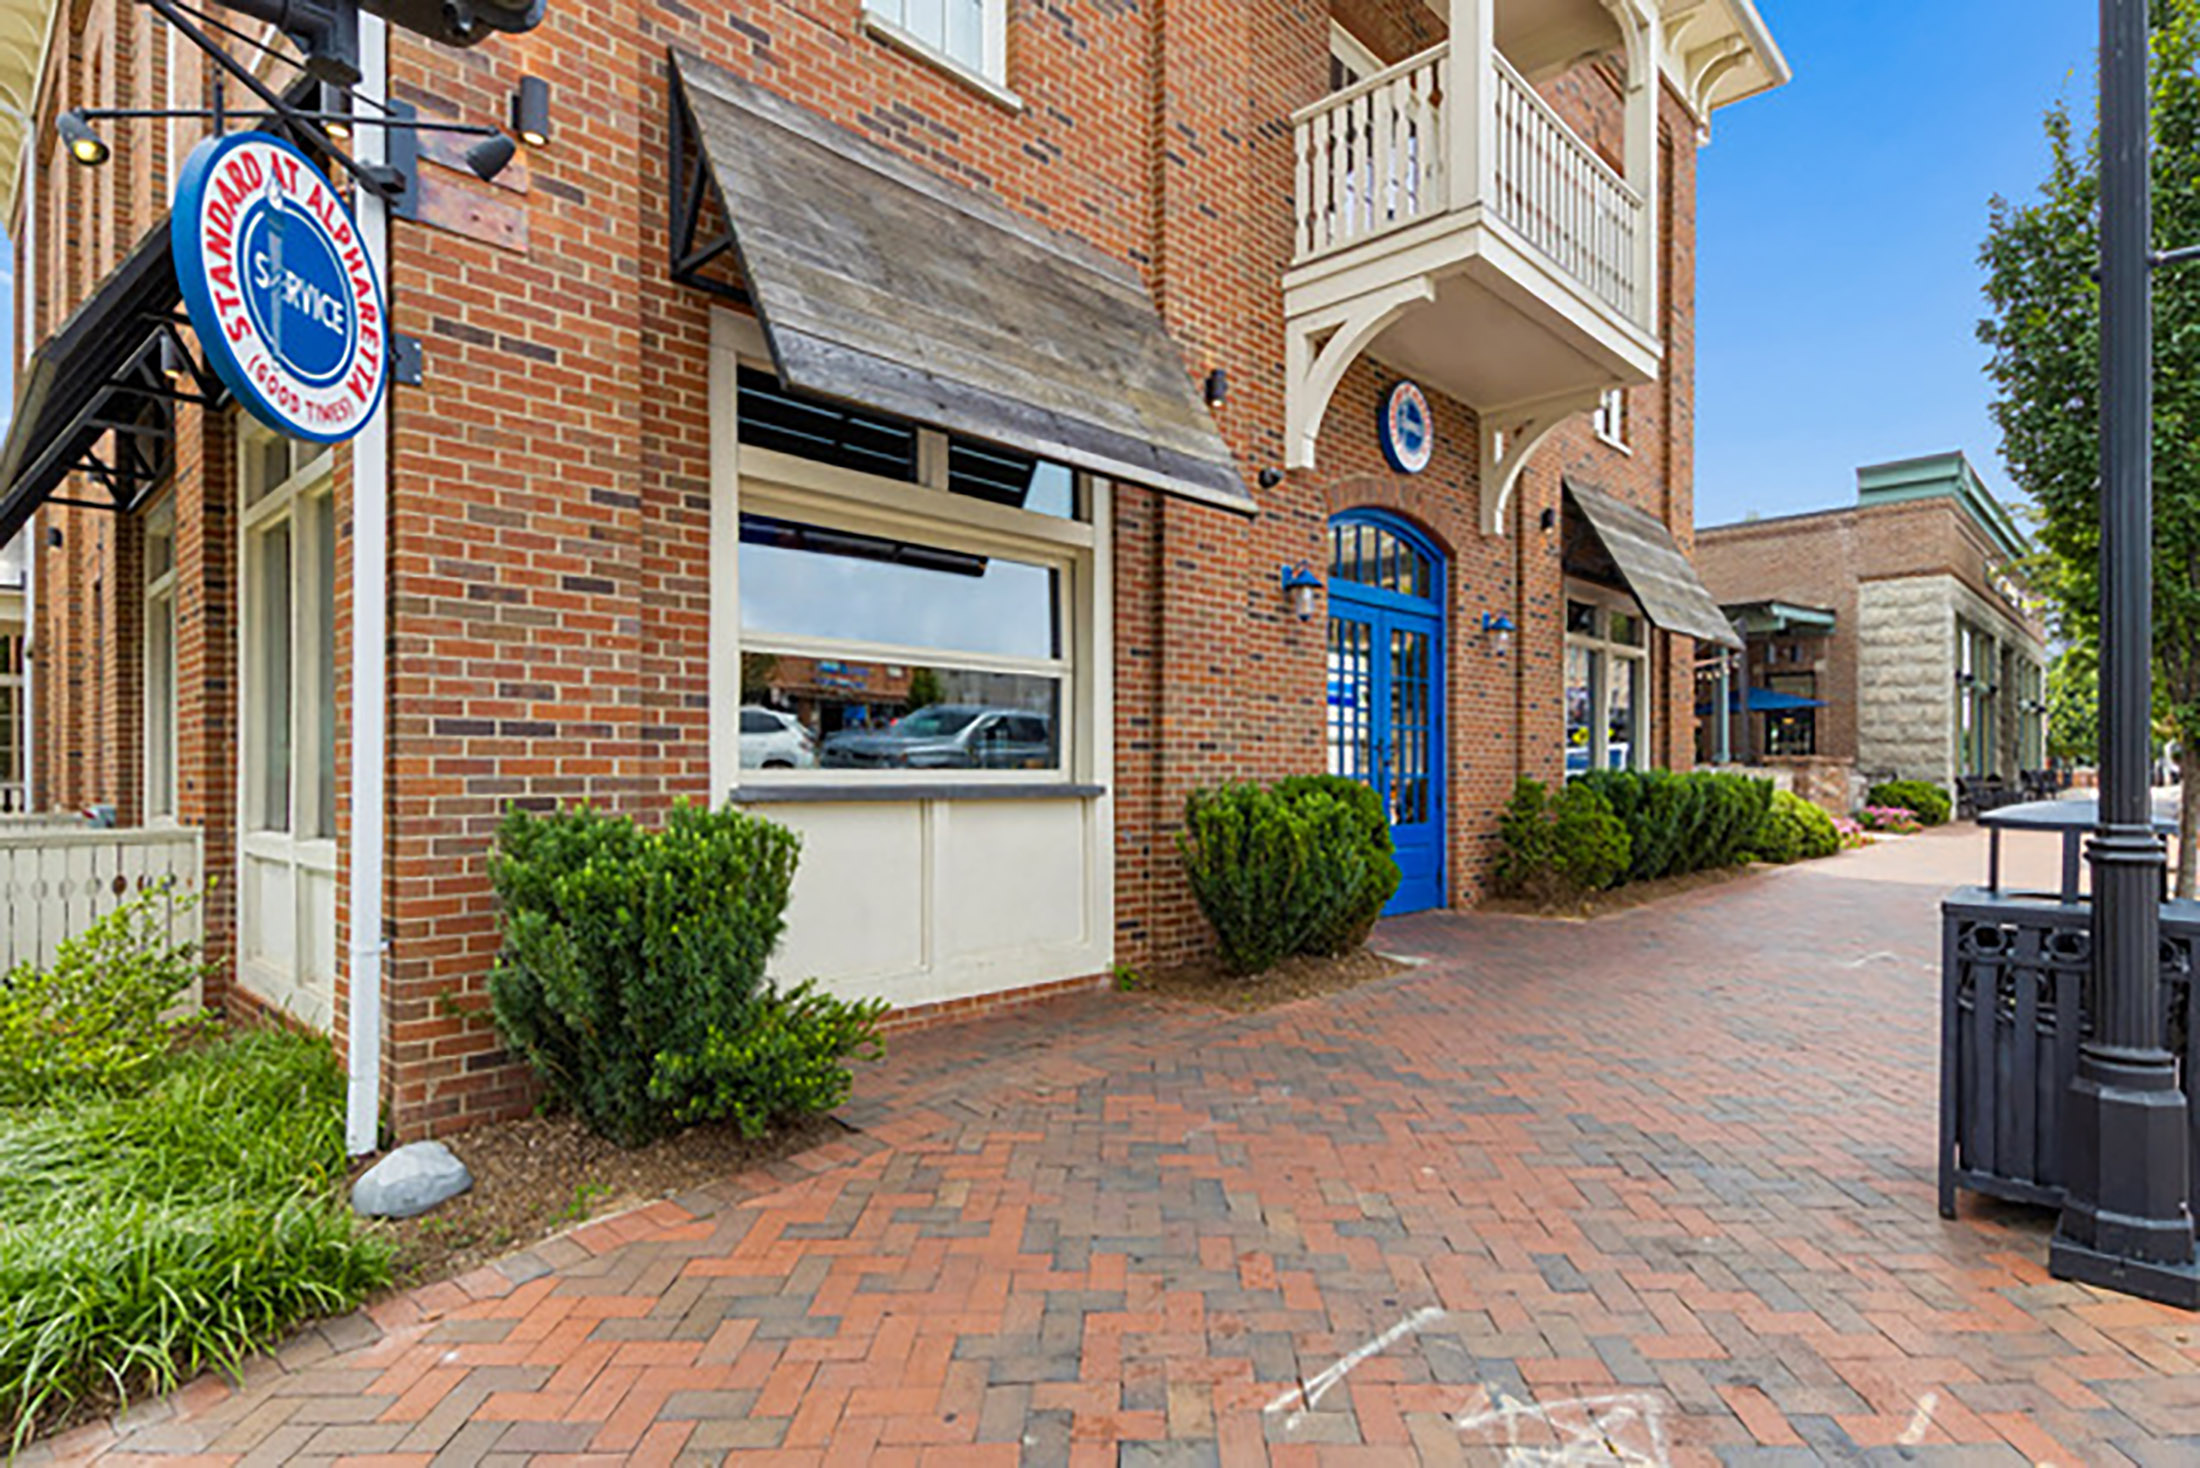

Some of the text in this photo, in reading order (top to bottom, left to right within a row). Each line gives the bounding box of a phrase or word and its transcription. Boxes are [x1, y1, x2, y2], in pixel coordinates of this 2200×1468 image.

[205, 151, 379, 402] STANDARD AT ALPHARETTA
